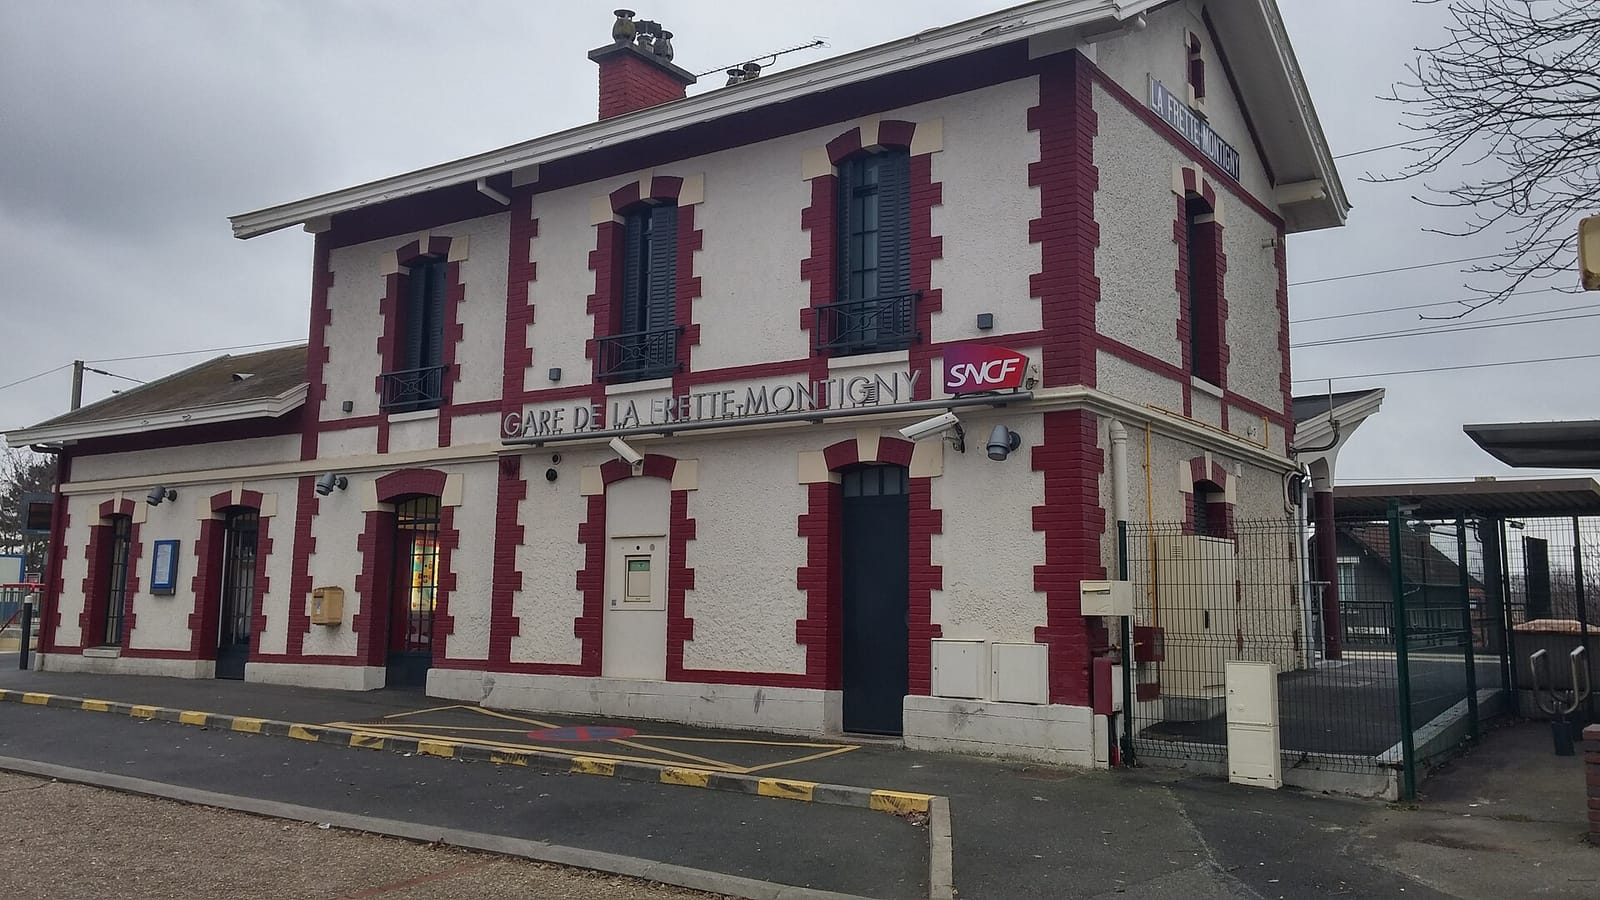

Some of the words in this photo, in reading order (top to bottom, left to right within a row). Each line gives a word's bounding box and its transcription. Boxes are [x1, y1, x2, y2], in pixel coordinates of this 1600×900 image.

[1151, 79, 1163, 114] LA
[1167, 94, 1239, 179] FRETTE-MONTIGNY
[503, 408, 565, 436] GARE
[574, 404, 602, 431] DE
[613, 399, 640, 427] LA
[651, 370, 920, 423] FRETTE-MONTIGNY
[947, 358, 1020, 387] SNCF
